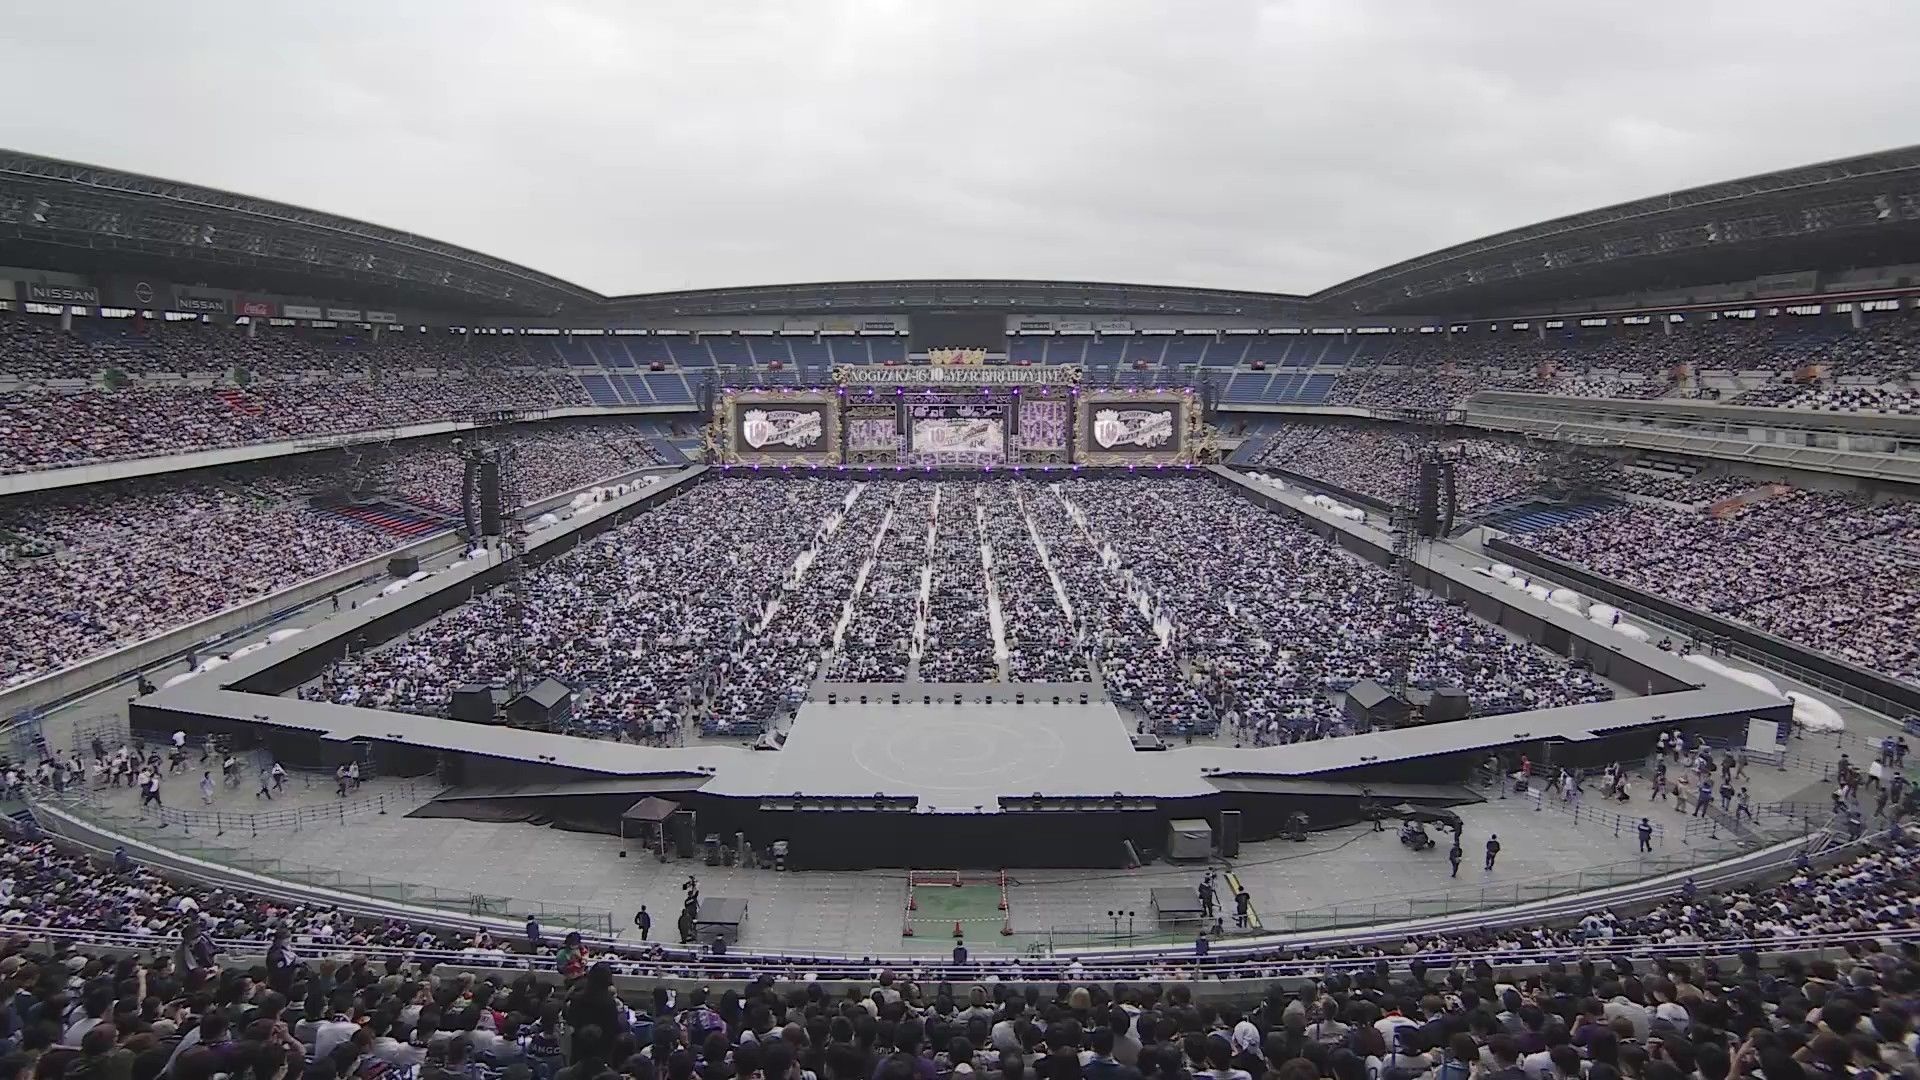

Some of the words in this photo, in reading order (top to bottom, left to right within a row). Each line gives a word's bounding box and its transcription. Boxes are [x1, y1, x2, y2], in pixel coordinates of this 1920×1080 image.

[32, 287, 95, 301] NISSAN
[179, 299, 224, 310] NISSAN
[950, 371, 978, 382] YEAR
